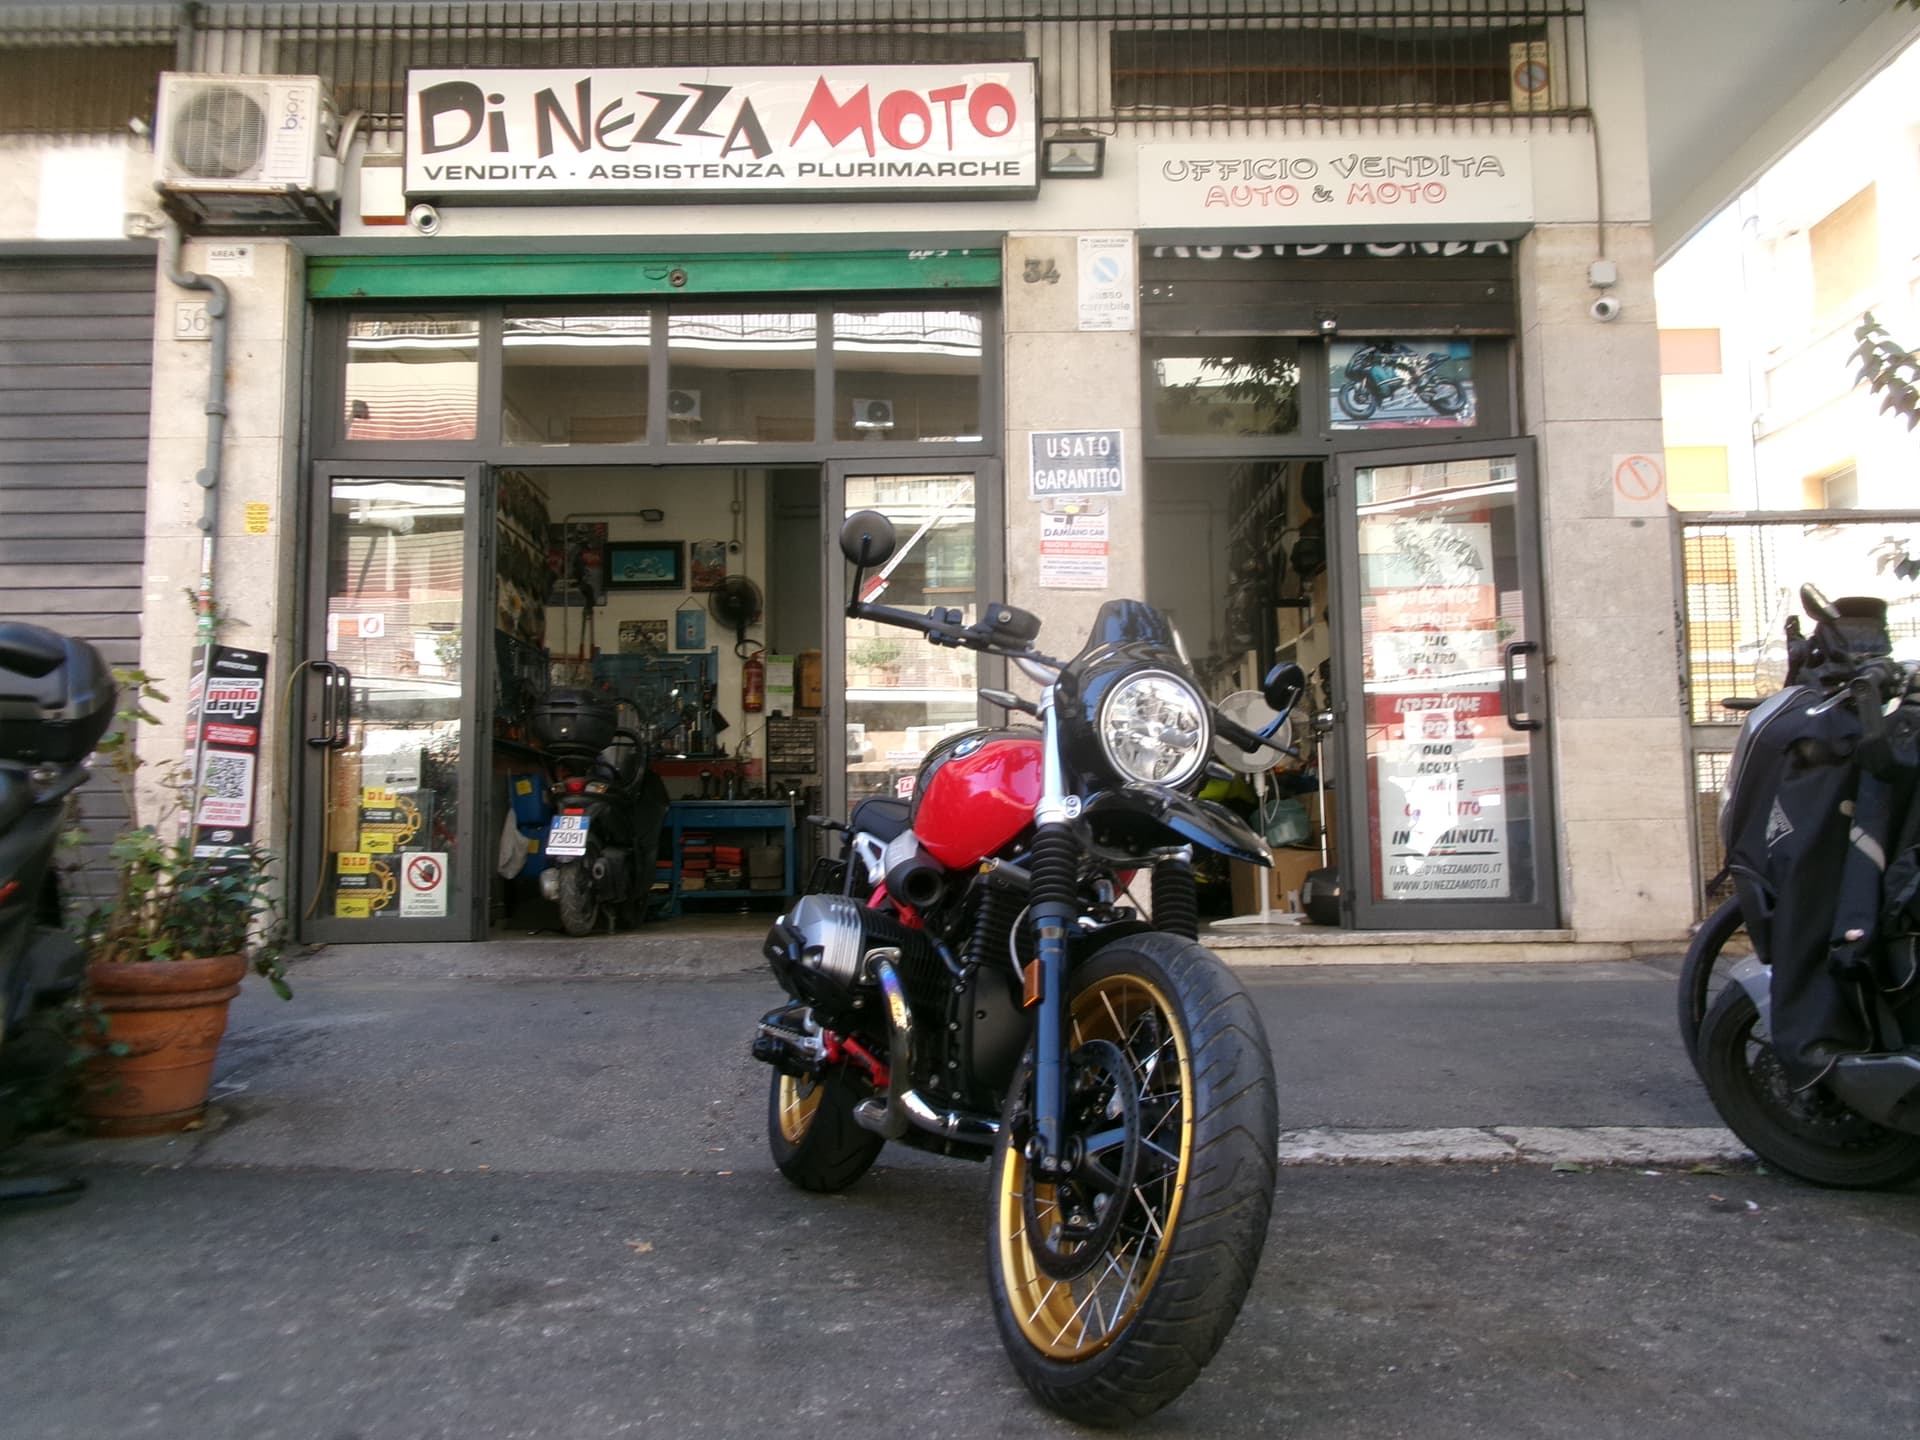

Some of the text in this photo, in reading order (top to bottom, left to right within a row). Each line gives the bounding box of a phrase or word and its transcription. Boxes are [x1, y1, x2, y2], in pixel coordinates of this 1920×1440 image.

[789, 74, 1017, 158] MOTO
[423, 164, 557, 181] VENDITA
[588, 163, 785, 180] ASSISTENZA
[798, 160, 1021, 178] PLURIMARCHE
[1162, 152, 1506, 183] UFFICIO VENDITA
[1204, 181, 1448, 208] AUTO & MOTO
[1022, 256, 1062, 284] 34
[178, 307, 210, 333] 36
[1046, 436, 1111, 458] USATO
[1034, 467, 1122, 490] GARANTITO
[1043, 528, 1088, 537] DAMIANO
[1412, 652, 1457, 664] FILTRO
[208, 688, 258, 700] moto
[206, 700, 256, 716] days
[1393, 696, 1482, 714] ISPEZIONE
[550, 831, 584, 845] 73091
[1391, 830, 1411, 845] IN
[1392, 878, 1501, 891] WWW.DINEZZAMOTO.IT
